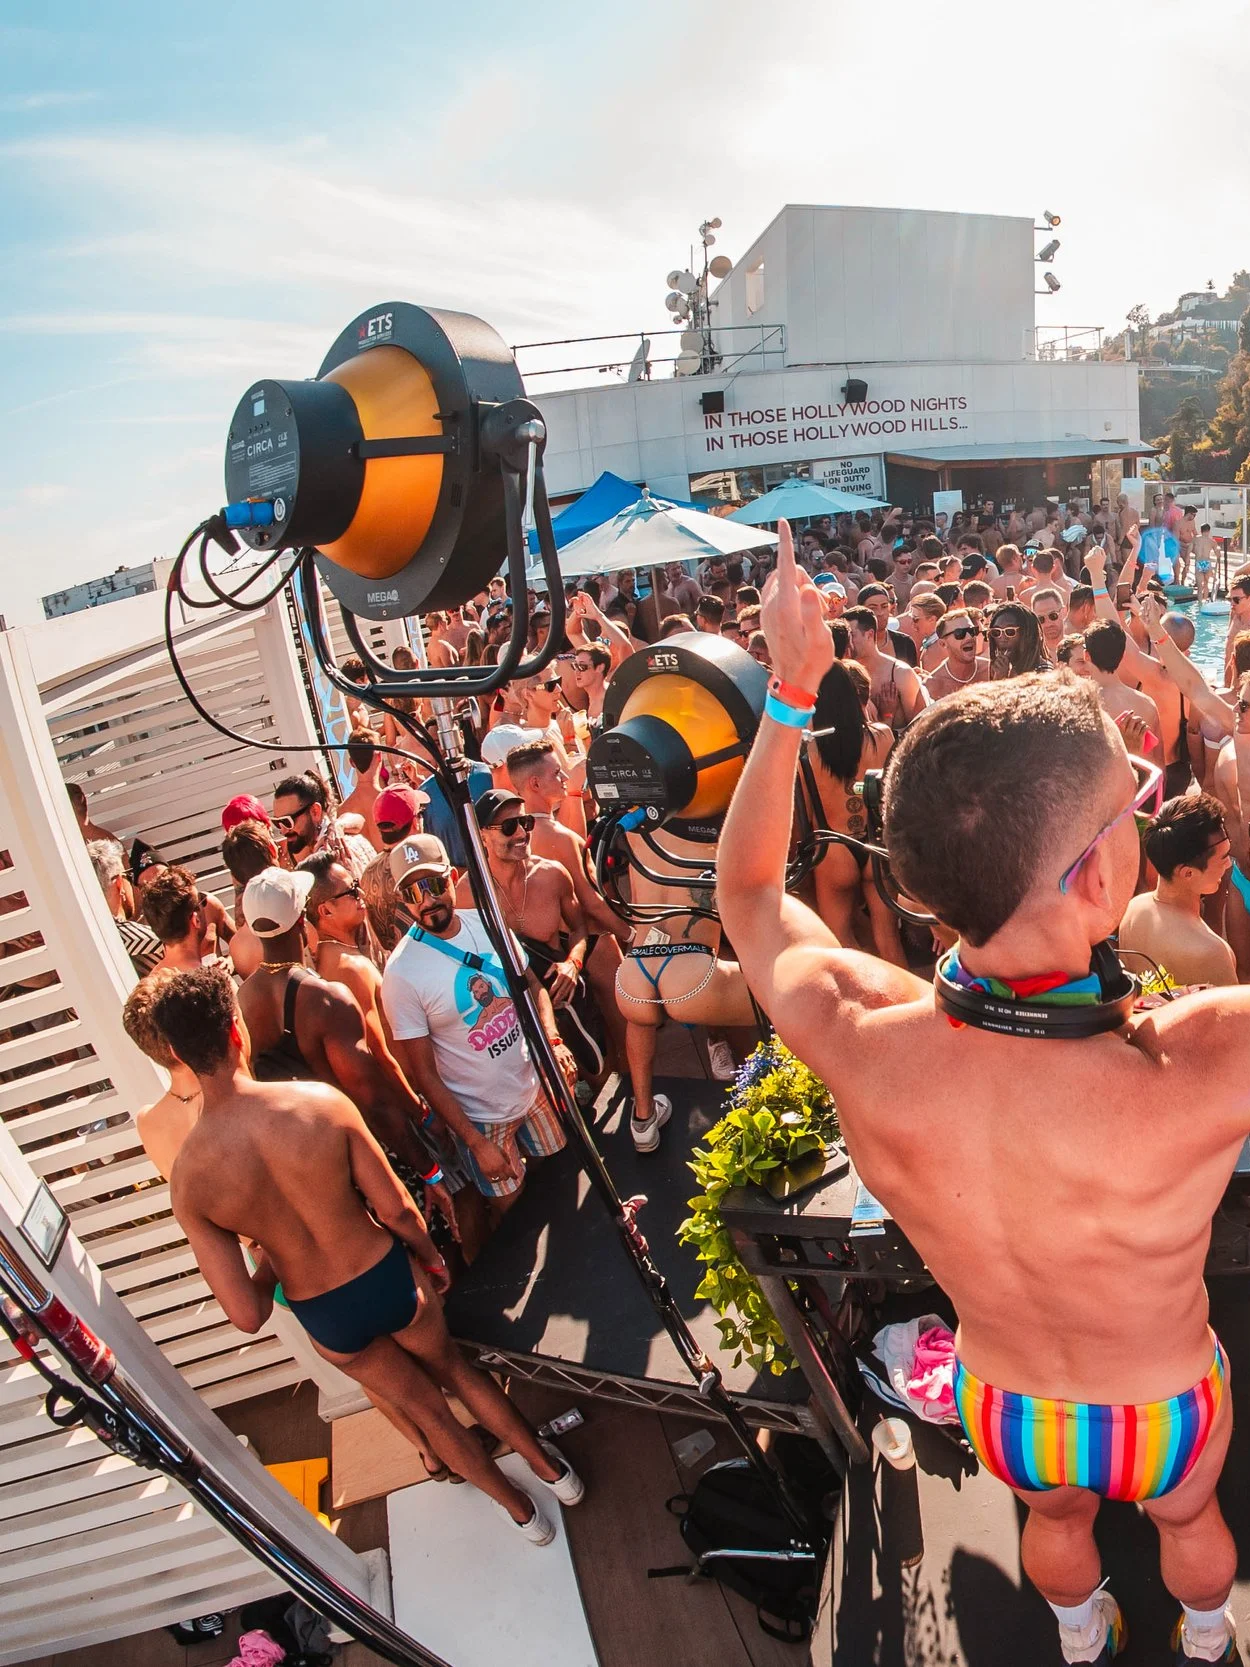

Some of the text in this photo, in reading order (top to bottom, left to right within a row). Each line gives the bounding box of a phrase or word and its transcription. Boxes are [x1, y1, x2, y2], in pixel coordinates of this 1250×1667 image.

[368, 313, 393, 337] ETS
[704, 397, 967, 429] IN THOSE HOLLYWOOD NIGHTS
[706, 417, 968, 452] IN THOSE HOLLYWOOD HILLS...
[247, 438, 274, 457] CIRCA
[823, 467, 870, 478] LIFEGUARD
[840, 461, 853, 469] NO
[828, 475, 866, 485] ON DUTY
[841, 483, 872, 493] DIVING
[654, 653, 679, 666] ETS
[610, 769, 638, 778] CIRCA
[402, 844, 420, 864] LA
[467, 1005, 518, 1051] DADD
[487, 1024, 520, 1059] ISSUES
